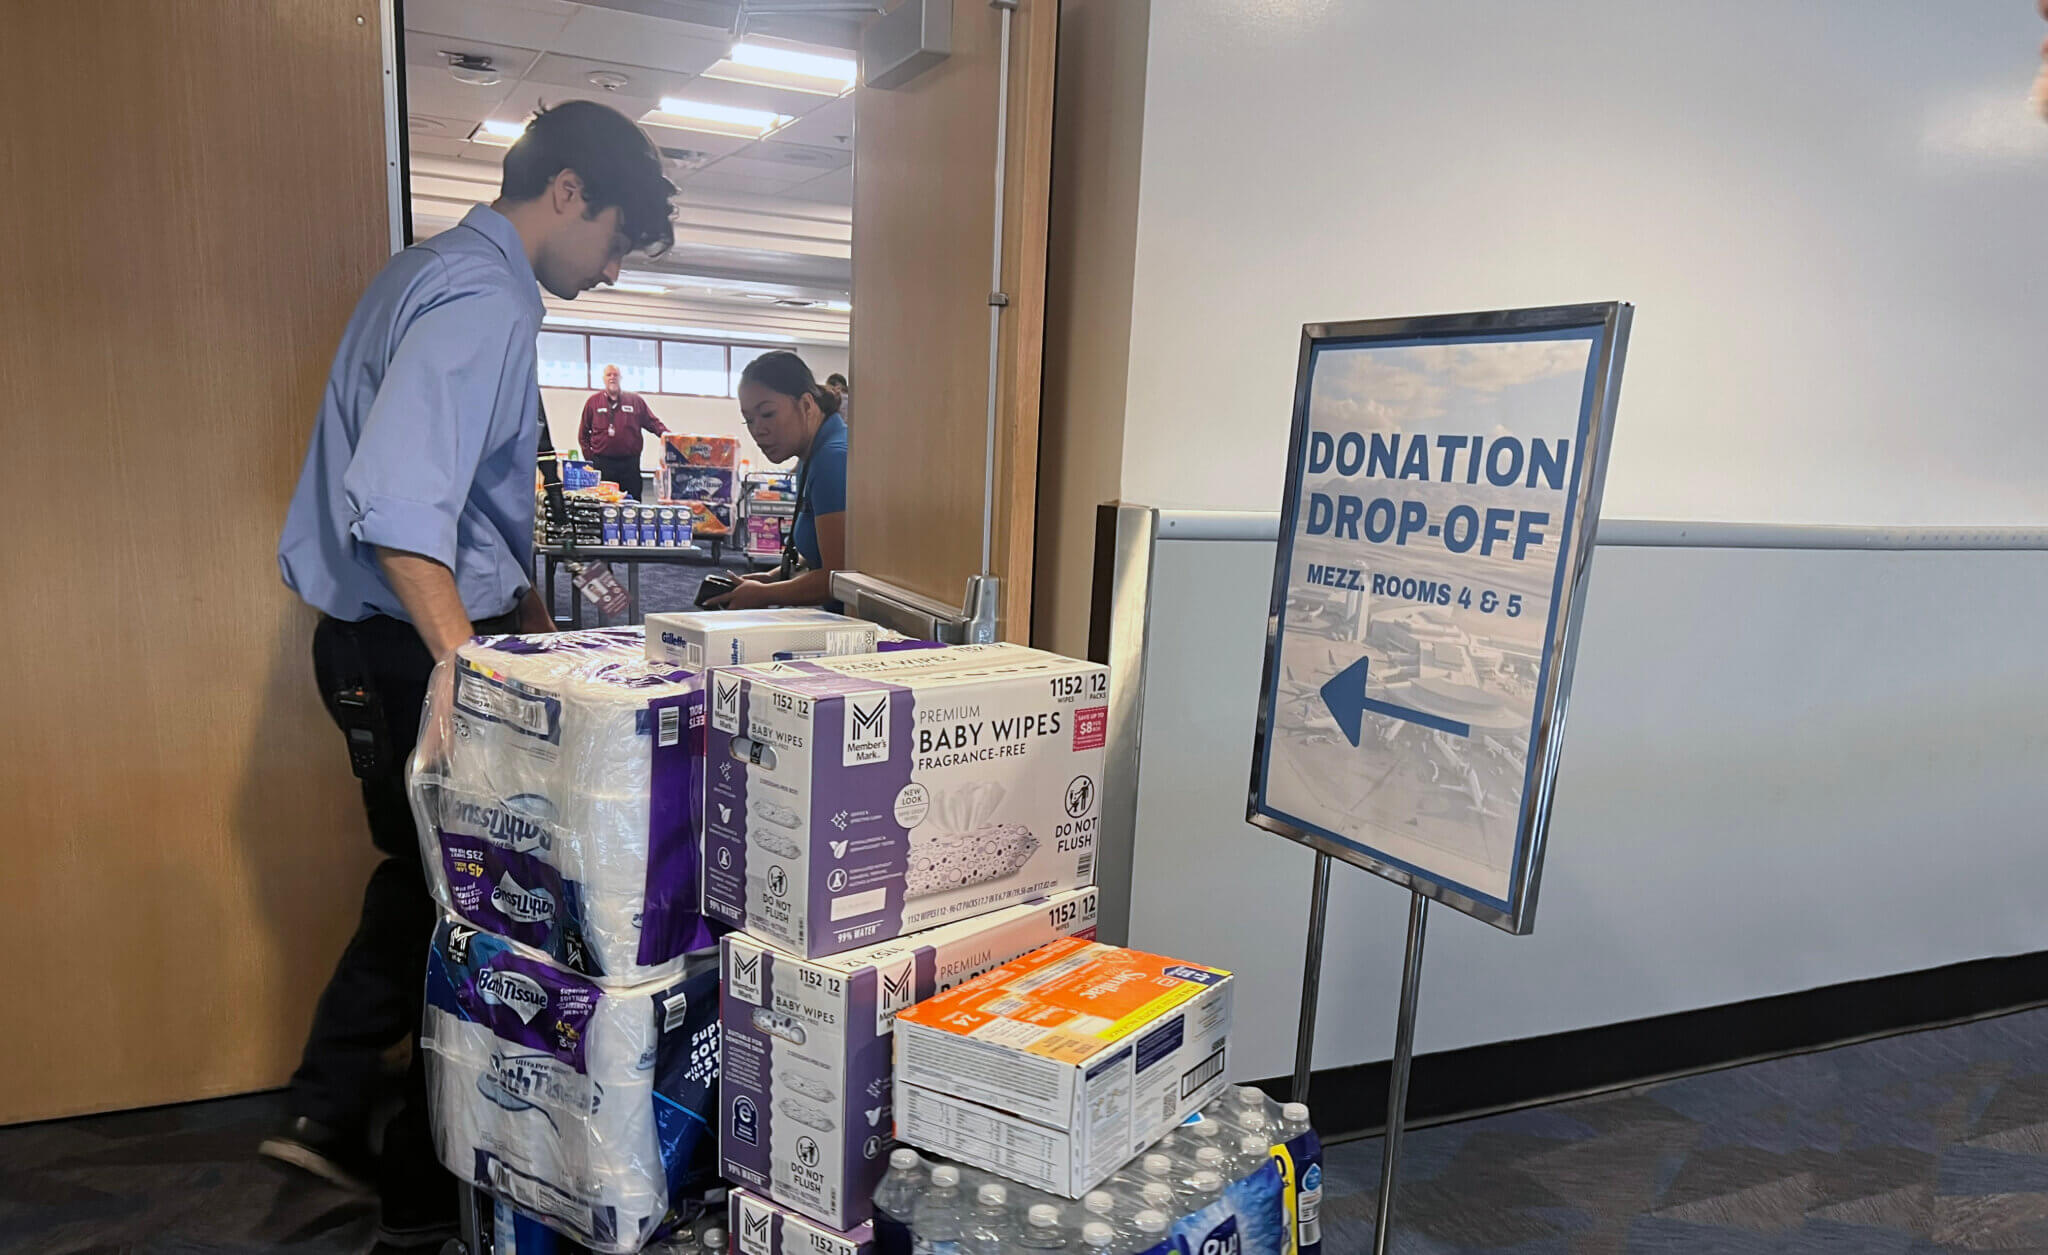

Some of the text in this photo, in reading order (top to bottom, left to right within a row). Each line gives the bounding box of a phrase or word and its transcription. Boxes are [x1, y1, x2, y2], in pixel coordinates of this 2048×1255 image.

[1307, 431, 1570, 490] DONATION
[1306, 493, 1550, 560] DROP-OFF
[1307, 563, 1522, 618] MEZZ. ROOMS 4 & 5
[661, 632, 687, 648] Gillette
[1050, 673, 1106, 697] 1152 12
[773, 692, 809, 715] 1152 12
[1090, 692, 1107, 700] PACKS
[920, 705, 981, 724] PREMIUM
[751, 723, 774, 739] BABY
[776, 730, 803, 748] WIPES
[919, 712, 1061, 753] BABY WIPES
[1080, 721, 1093, 735] $8
[847, 739, 887, 753] Member's
[918, 743, 1026, 771] FRAGRANCE-FREE
[902, 796, 922, 805] LOOK
[903, 788, 921, 797] NEW
[1055, 817, 1097, 838] DO NOT
[1057, 834, 1092, 853] FLUSH
[466, 849, 484, 861] 235
[468, 863, 484, 878] 45
[763, 893, 792, 913] DO NOT
[1049, 894, 1096, 927] 1152 12
[765, 906, 789, 924] FLUSH
[854, 926, 877, 940] WATER
[940, 950, 992, 979] PREMIUM
[479, 970, 548, 1008] BathTissue
[799, 968, 840, 993] 1152 12
[1079, 969, 1147, 1000] Similac
[776, 996, 801, 1012] BABY
[804, 1005, 835, 1024] WIPES
[951, 1013, 981, 1027] 24
[684, 1063, 704, 1079] with
[691, 1069, 705, 1082] the
[791, 1162, 825, 1184] DO NOT
[794, 1175, 821, 1193] FLUSH
[810, 1233, 833, 1254] 1152
